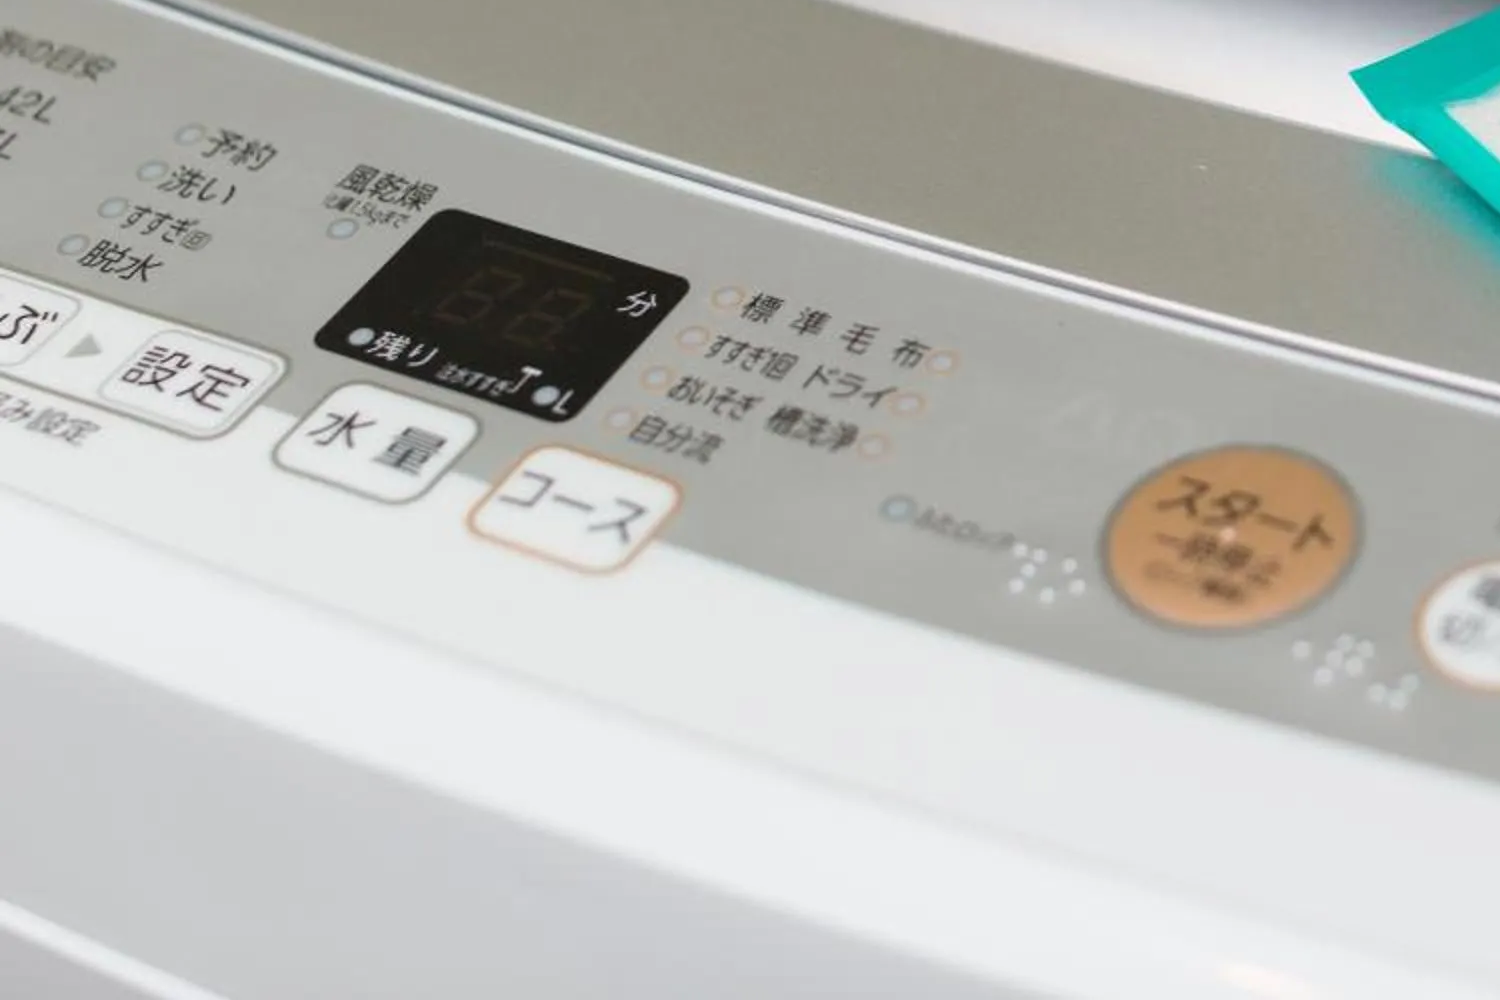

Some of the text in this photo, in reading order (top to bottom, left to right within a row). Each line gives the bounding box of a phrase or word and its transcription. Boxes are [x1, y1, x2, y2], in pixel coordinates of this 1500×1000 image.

[202, 129, 278, 172] 予約
[157, 165, 236, 205] 洗い
[334, 164, 439, 213] 風乾燥
[77, 238, 164, 282] 脱水
[616, 290, 657, 317] 分
[367, 331, 439, 367] 残り
[741, 292, 933, 370] 標準 毛布
[120, 345, 251, 413] 設定
[665, 375, 763, 422] おいそぎ
[802, 362, 898, 410] ドライ
[307, 411, 448, 476] 水量
[499, 470, 648, 543] コース
[1155, 473, 1337, 555] スタート
